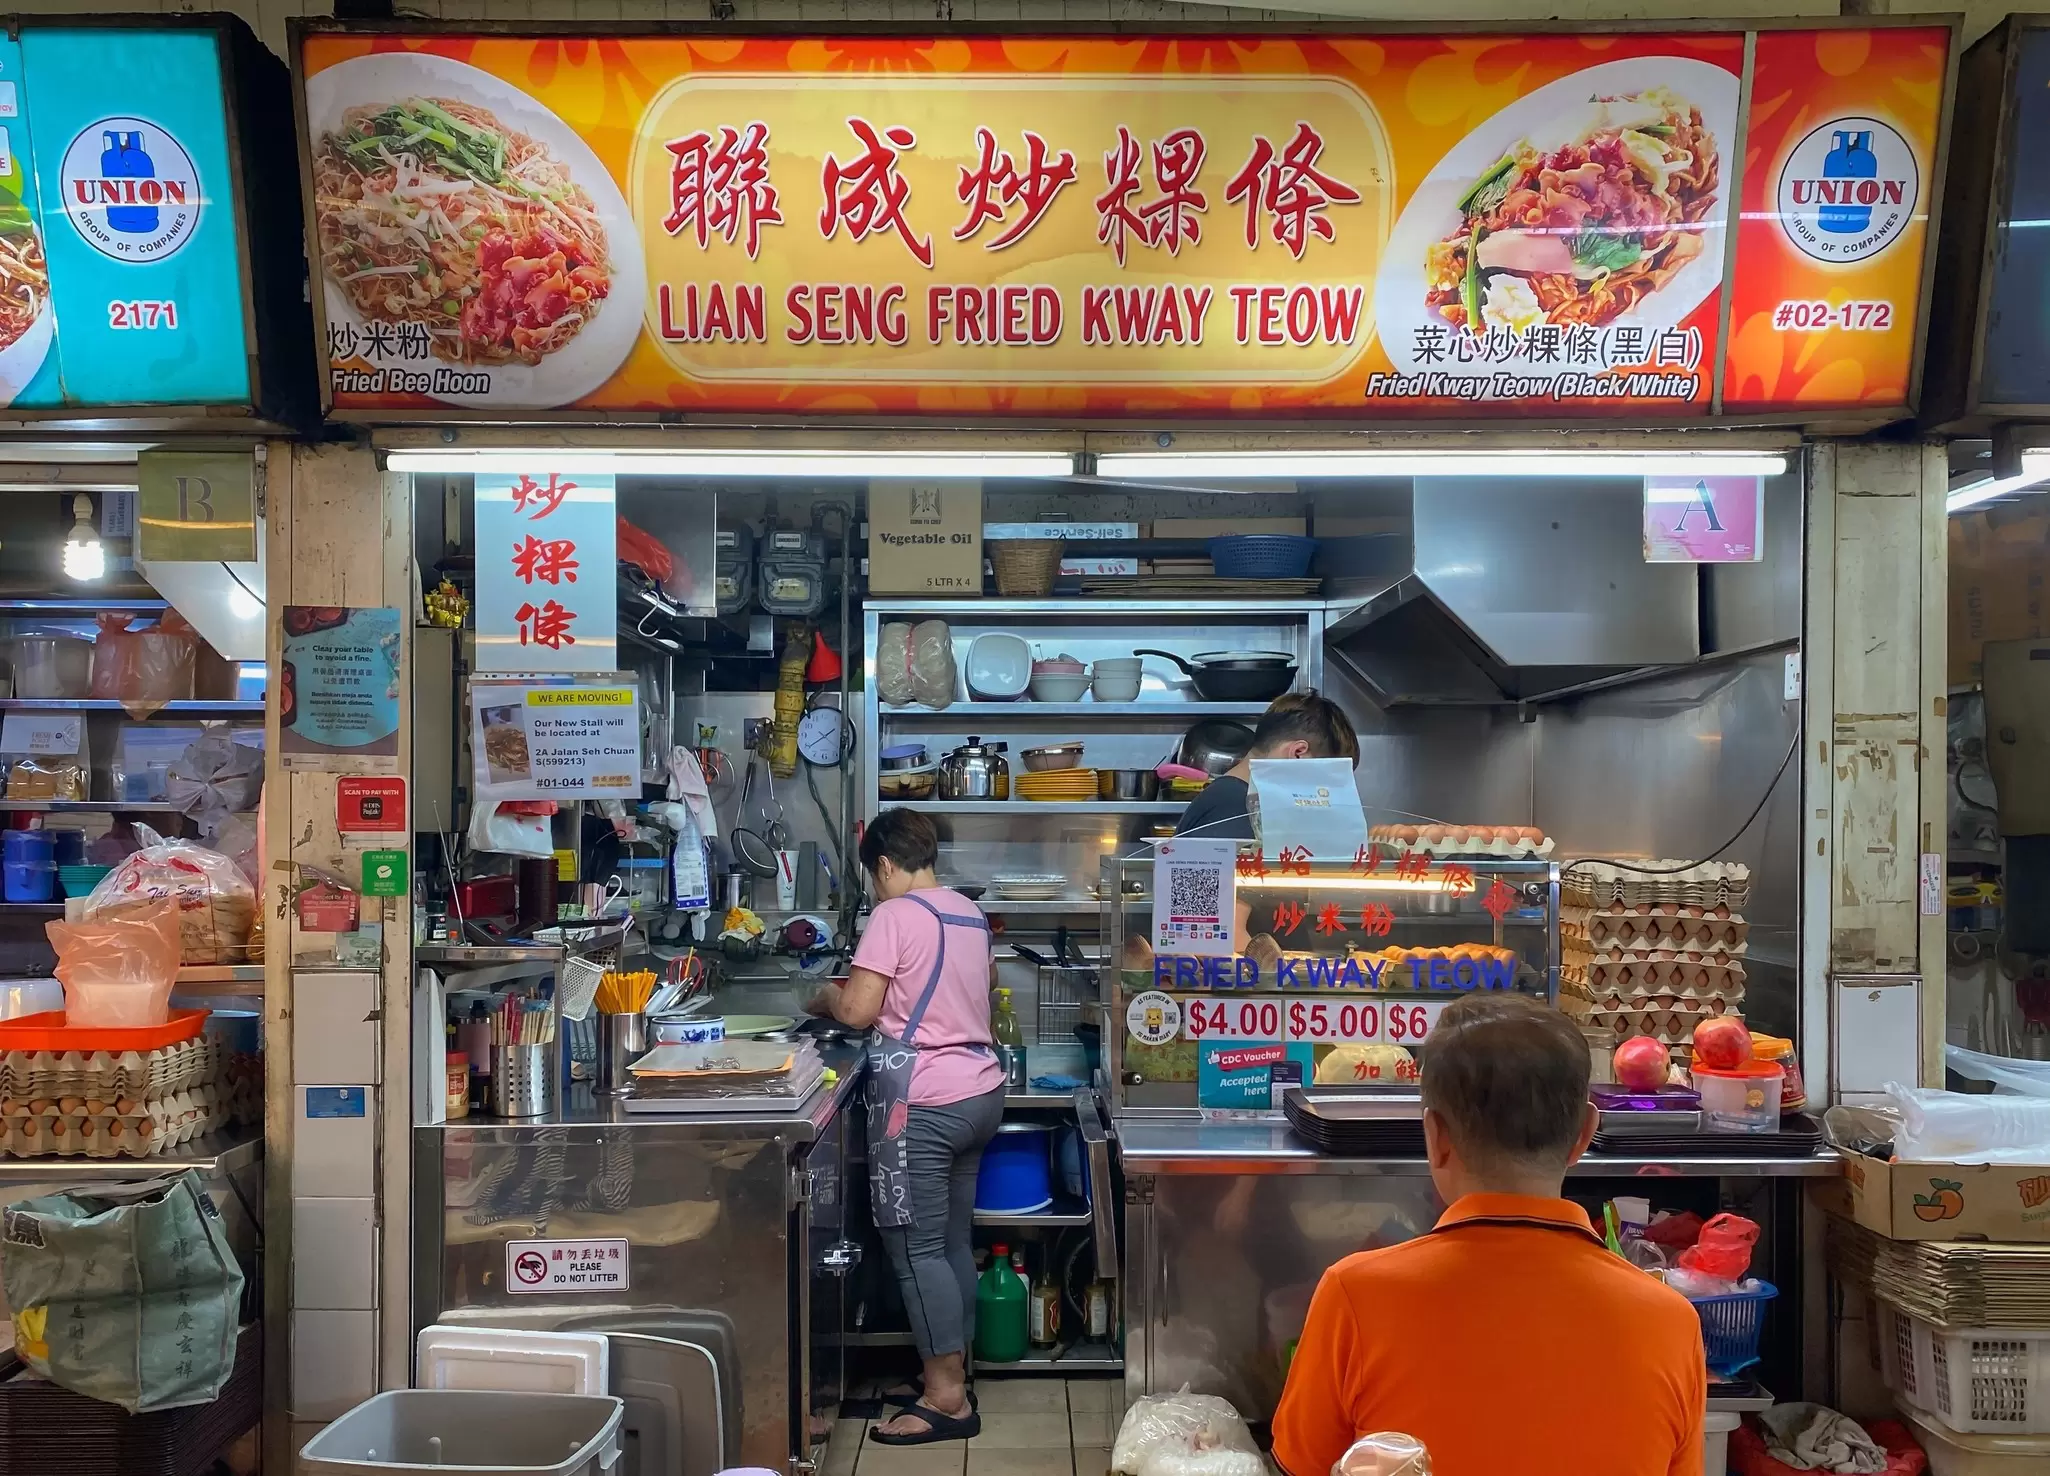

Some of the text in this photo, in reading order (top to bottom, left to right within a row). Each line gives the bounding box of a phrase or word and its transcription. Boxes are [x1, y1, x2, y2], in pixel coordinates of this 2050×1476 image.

[73, 180, 186, 205] UNION
[662, 117, 1362, 268] 聯成炒粿條
[1792, 179, 1906, 205] UNION
[80, 211, 187, 253] GROUP OF COMPANIES
[1791, 211, 1899, 254] GROUP OF COMPANIES
[110, 302, 177, 327] 2171
[659, 283, 1364, 347] LIAN SENG FRIED KWAY TEOW
[1776, 303, 1891, 328] #02-172
[326, 321, 432, 361] 炒米粉
[1411, 324, 1704, 368] 菜心炒粿條(黑/白)
[331, 369, 491, 394] Fried Bee Hoon
[1366, 372, 1700, 401] Fried Kway Teow (Black/White)
[175, 476, 216, 523] B
[1673, 479, 1726, 532] A
[879, 532, 972, 547] Vegetable Oil
[1044, 528, 1124, 538] Self-Service
[511, 473, 580, 651] 炒粿條
[926, 578, 971, 587] 5 LTR X 4
[312, 644, 374, 654] Clear your table
[325, 654, 347, 662] avoid
[354, 654, 372, 662] fine.
[538, 693, 622, 703] WE ARE MOVING!
[534, 718, 624, 728] Our New Stall will
[534, 729, 601, 738] be located at
[535, 747, 635, 757] 2A Jalan Seh Chuan
[535, 757, 586, 767] S(599213)
[536, 778, 585, 788] #01-044
[147, 887, 170, 900] Tai
[1273, 900, 1396, 937] 炒米粉
[1154, 956, 1517, 992] FRIED KWAY TEOW
[1143, 993, 1166, 1003] FEATURED
[1189, 1000, 1278, 1037] $4.00
[1289, 1001, 1379, 1038] $5.00
[1388, 1003, 1428, 1043] $6
[1143, 1034, 1159, 1042] MAKAN
[1158, 1029, 1172, 1041] DIARY
[1221, 1050, 1282, 1065] CDC Voucher
[1219, 1072, 1268, 1089] Accepted
[1243, 1084, 1268, 1097] here
[889, 1171, 913, 1226] LOVE
[1628, 1226, 1646, 1236] BRAN
[553, 1273, 619, 1284] DO NOT LITTER
[570, 1262, 602, 1272] PLEASE
